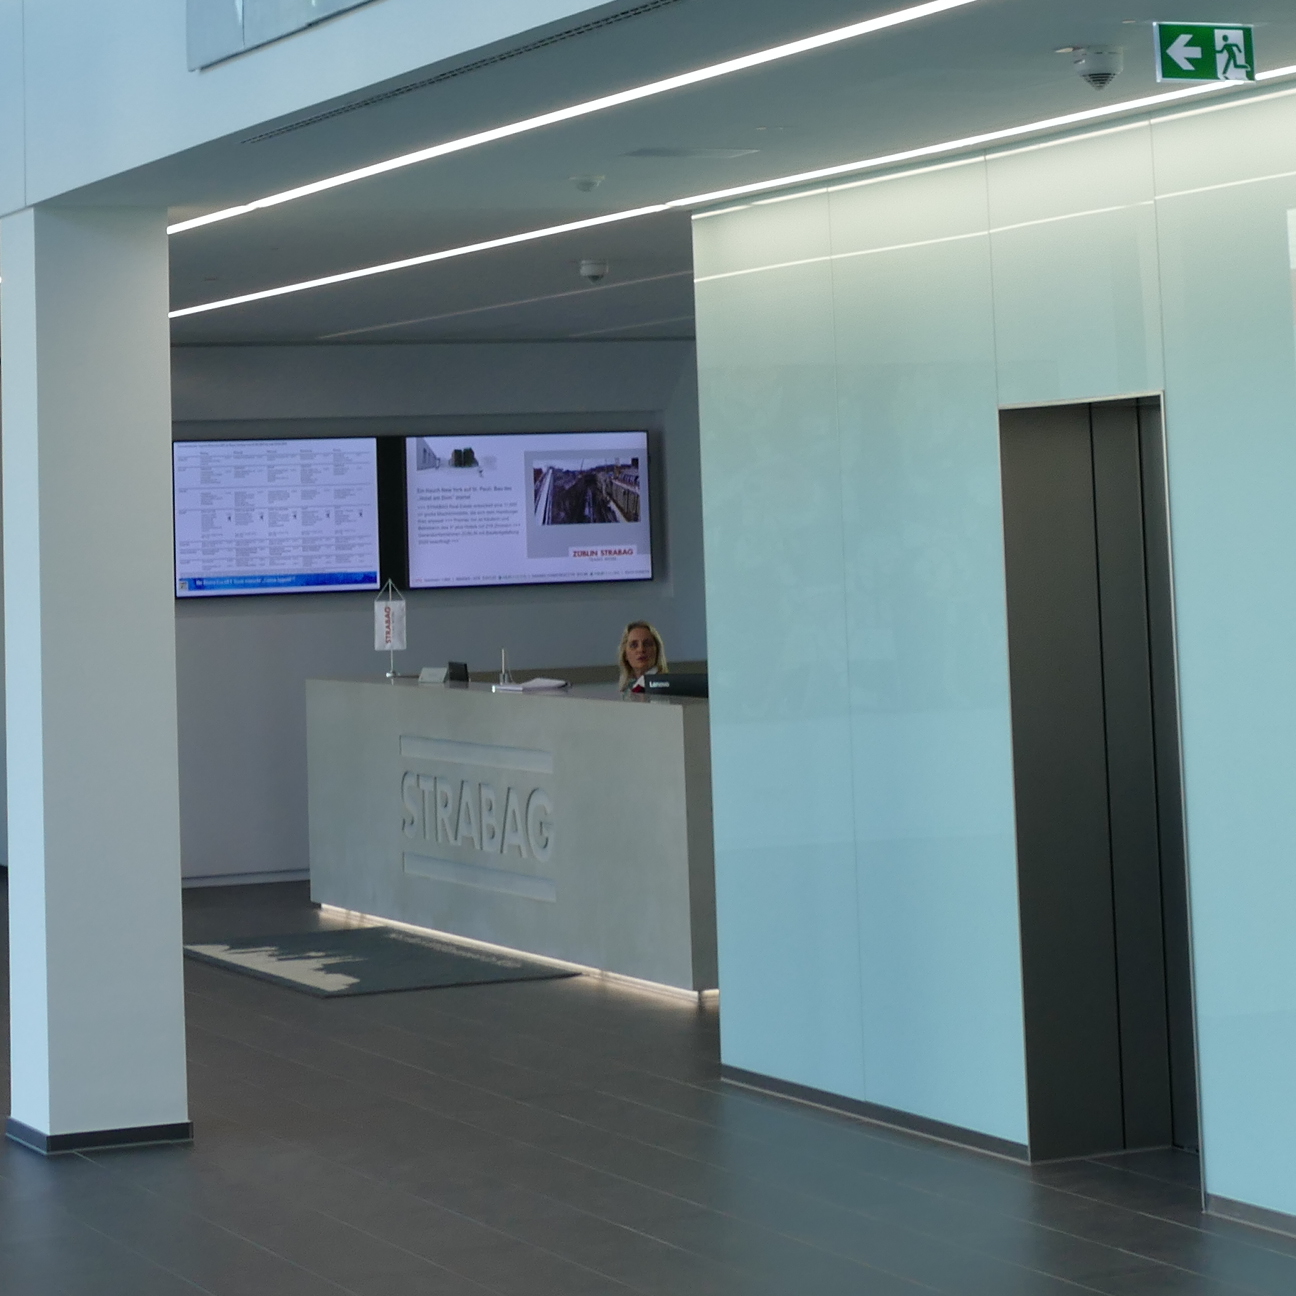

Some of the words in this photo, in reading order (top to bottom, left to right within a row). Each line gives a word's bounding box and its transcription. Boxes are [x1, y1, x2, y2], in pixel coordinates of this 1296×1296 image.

[573, 549, 598, 558] ZÜBLIN
[601, 548, 634, 557] STRABAG
[401, 770, 553, 863] STRABAG
